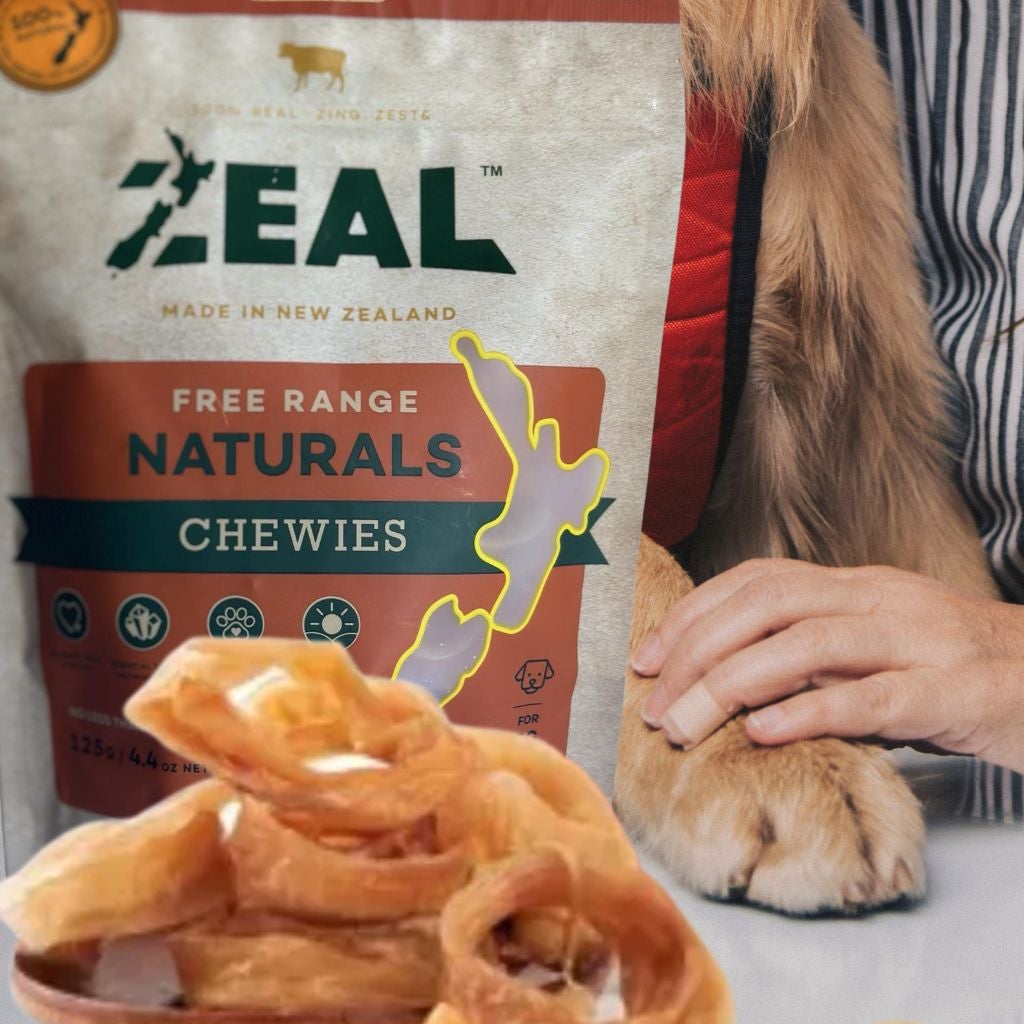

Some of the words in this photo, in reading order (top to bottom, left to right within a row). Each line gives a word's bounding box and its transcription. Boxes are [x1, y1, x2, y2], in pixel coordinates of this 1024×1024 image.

[106, 128, 517, 276] ZEAL
[162, 304, 231, 320] MADE
[242, 305, 266, 320] IN
[277, 306, 330, 321] NEW
[343, 306, 457, 322] ZEALAND
[172, 388, 265, 414] FREE
[283, 389, 418, 414] RANGE
[128, 432, 464, 478] NATURALS
[178, 517, 408, 553] CHEWIES
[517, 713, 540, 726] FOR
[129, 747, 159, 770] 4.4
[161, 762, 178, 774] OZ
